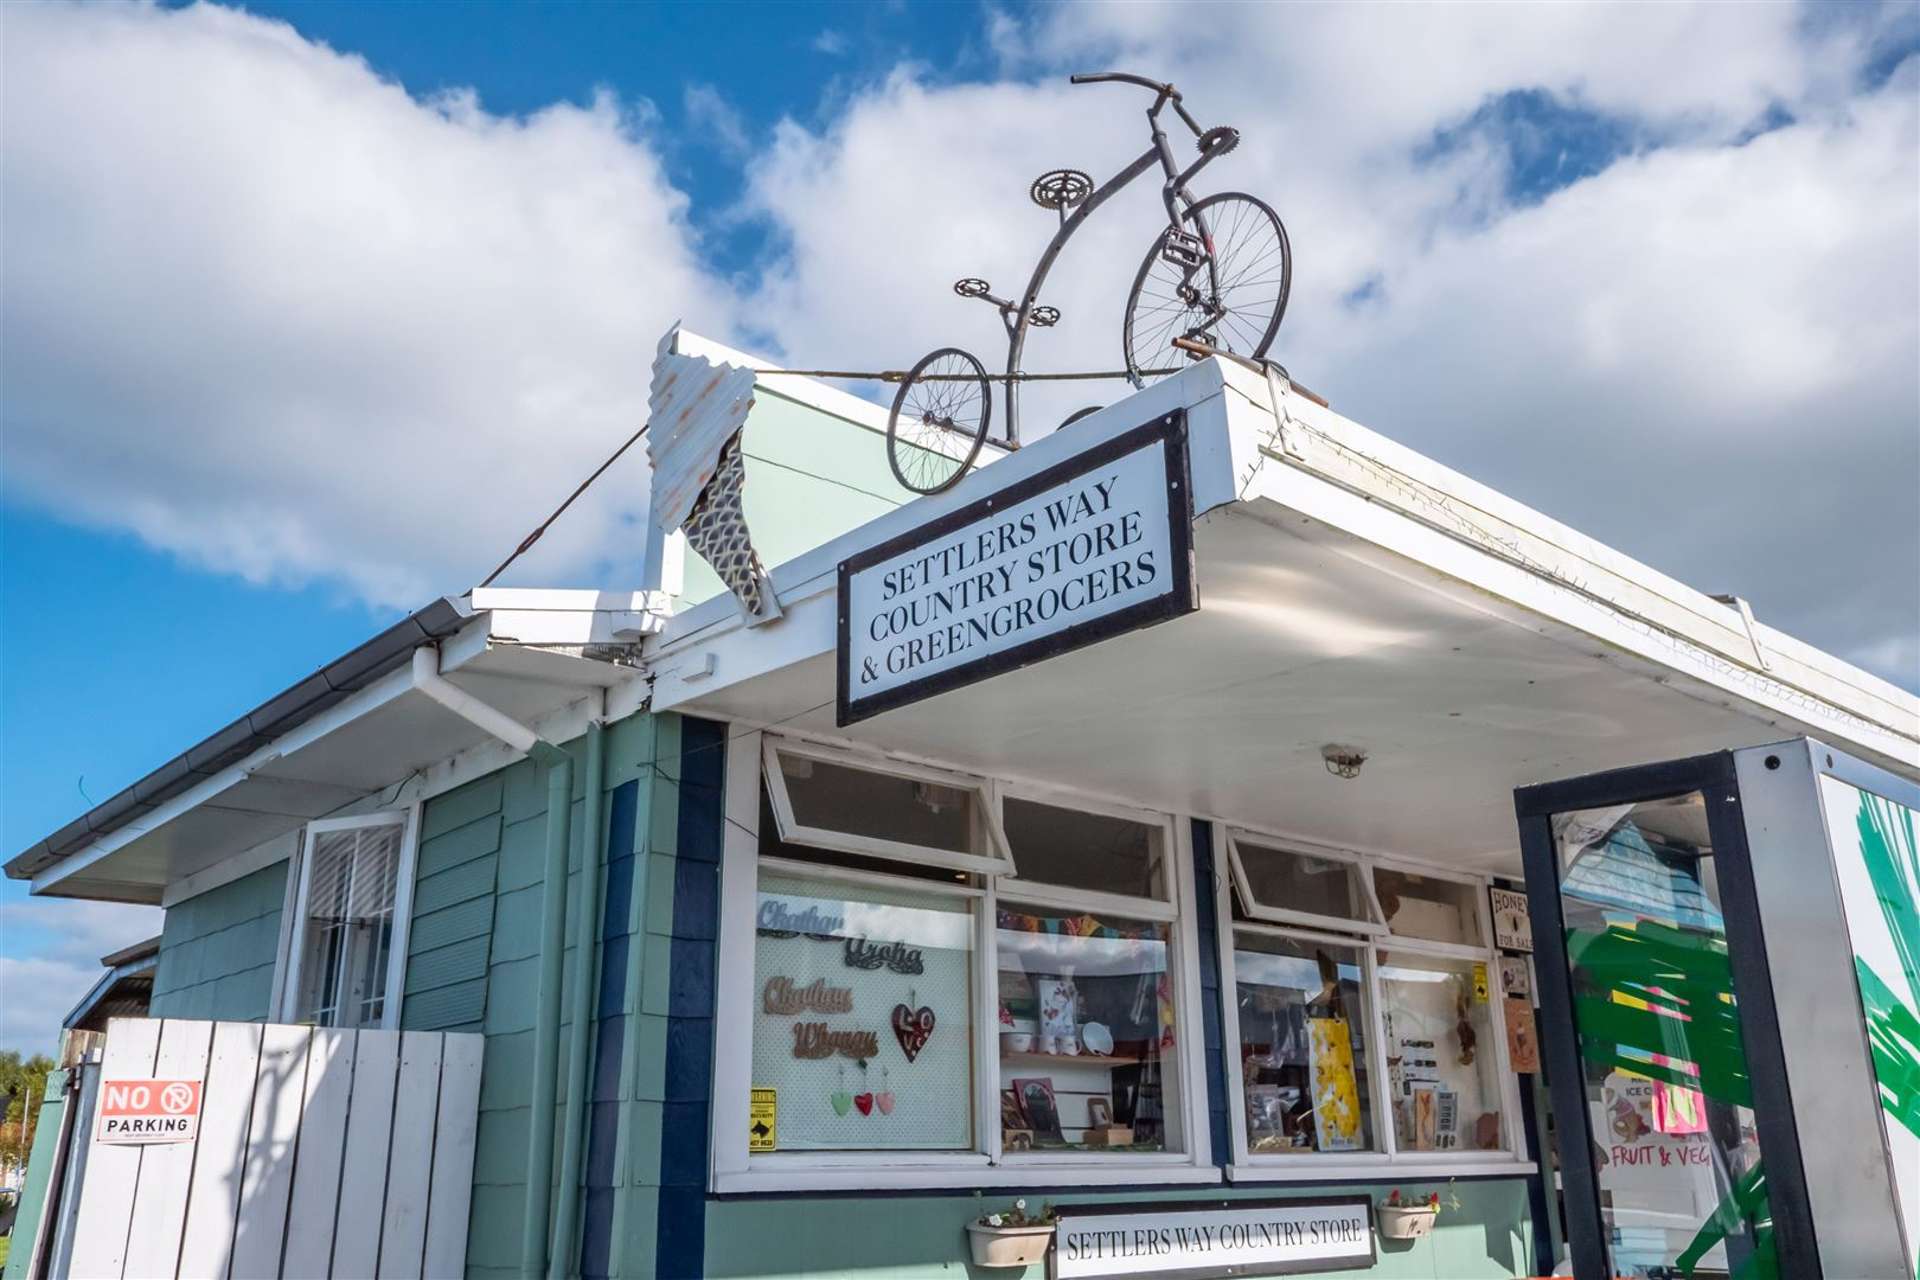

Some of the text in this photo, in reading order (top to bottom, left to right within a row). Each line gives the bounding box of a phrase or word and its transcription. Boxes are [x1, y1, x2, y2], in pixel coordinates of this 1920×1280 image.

[882, 475, 1119, 601] SETTLERS WAY
[869, 511, 1144, 643] COUNTRY STORE
[860, 550, 1157, 685] & GREENGROCERS
[107, 1086, 151, 1110] NO
[1626, 1087, 1642, 1097] ICE
[107, 1119, 188, 1132] PARKING
[1612, 1145, 1711, 1167] FRUIT & VEG
[1067, 1218, 1362, 1260] SETTLERS WAY COUNTRY STORE
